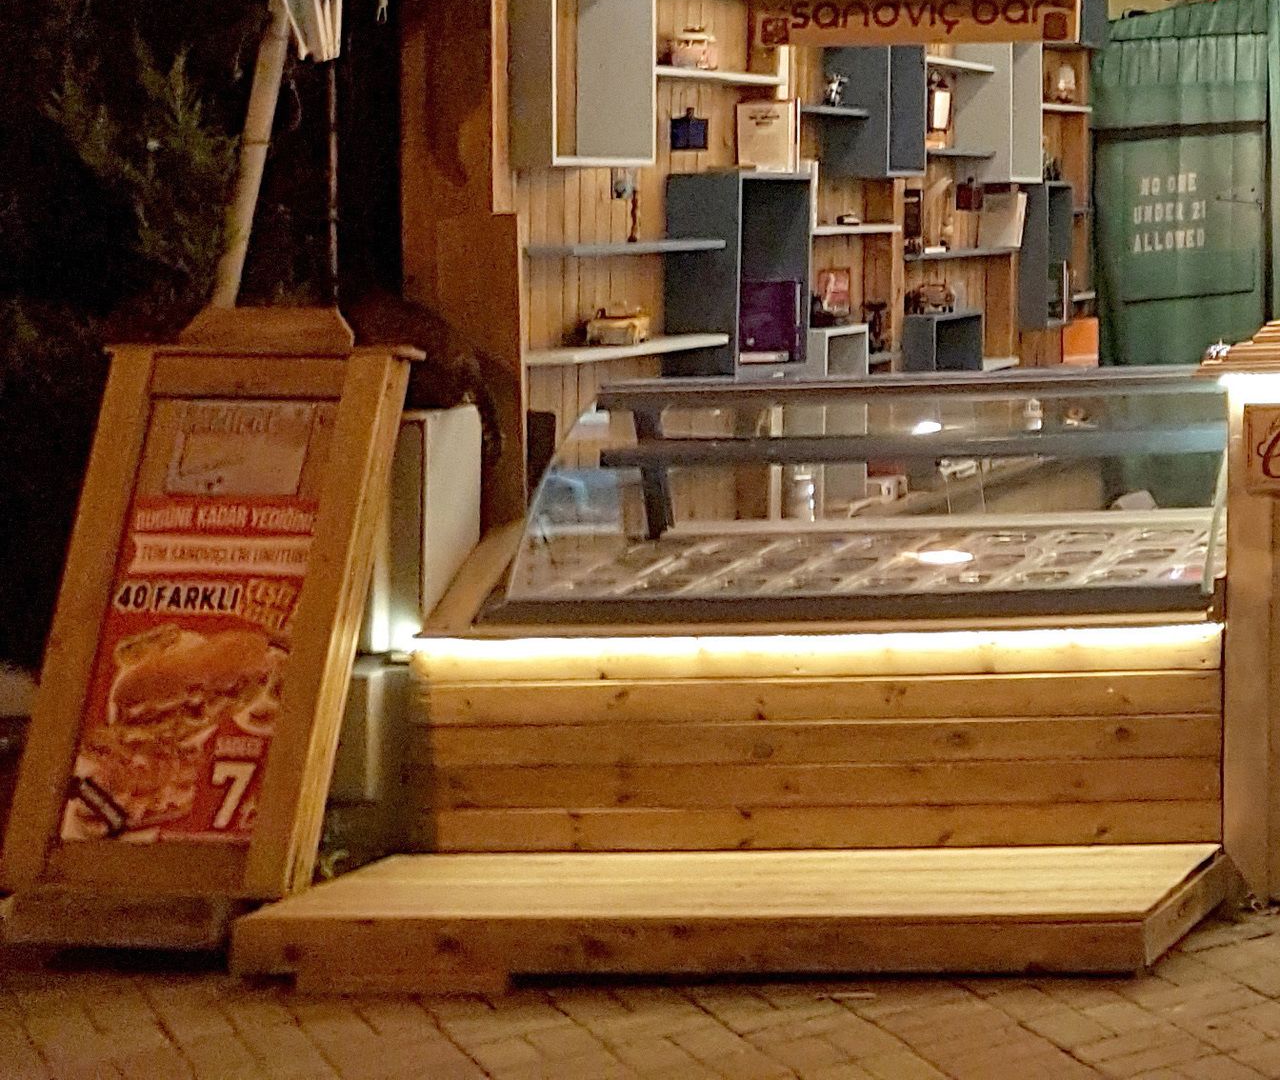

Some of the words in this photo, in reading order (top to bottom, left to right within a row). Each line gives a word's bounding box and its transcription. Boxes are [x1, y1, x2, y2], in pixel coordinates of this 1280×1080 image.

[1140, 177, 1160, 196] NO
[1167, 172, 1197, 194] ONE
[1133, 202, 1184, 225] UNDER
[1191, 200, 1206, 220] 21
[1133, 229, 1205, 254] ALLOWED
[116, 584, 149, 609] 40
[154, 585, 242, 611] FARKLI
[212, 761, 257, 829] 7
